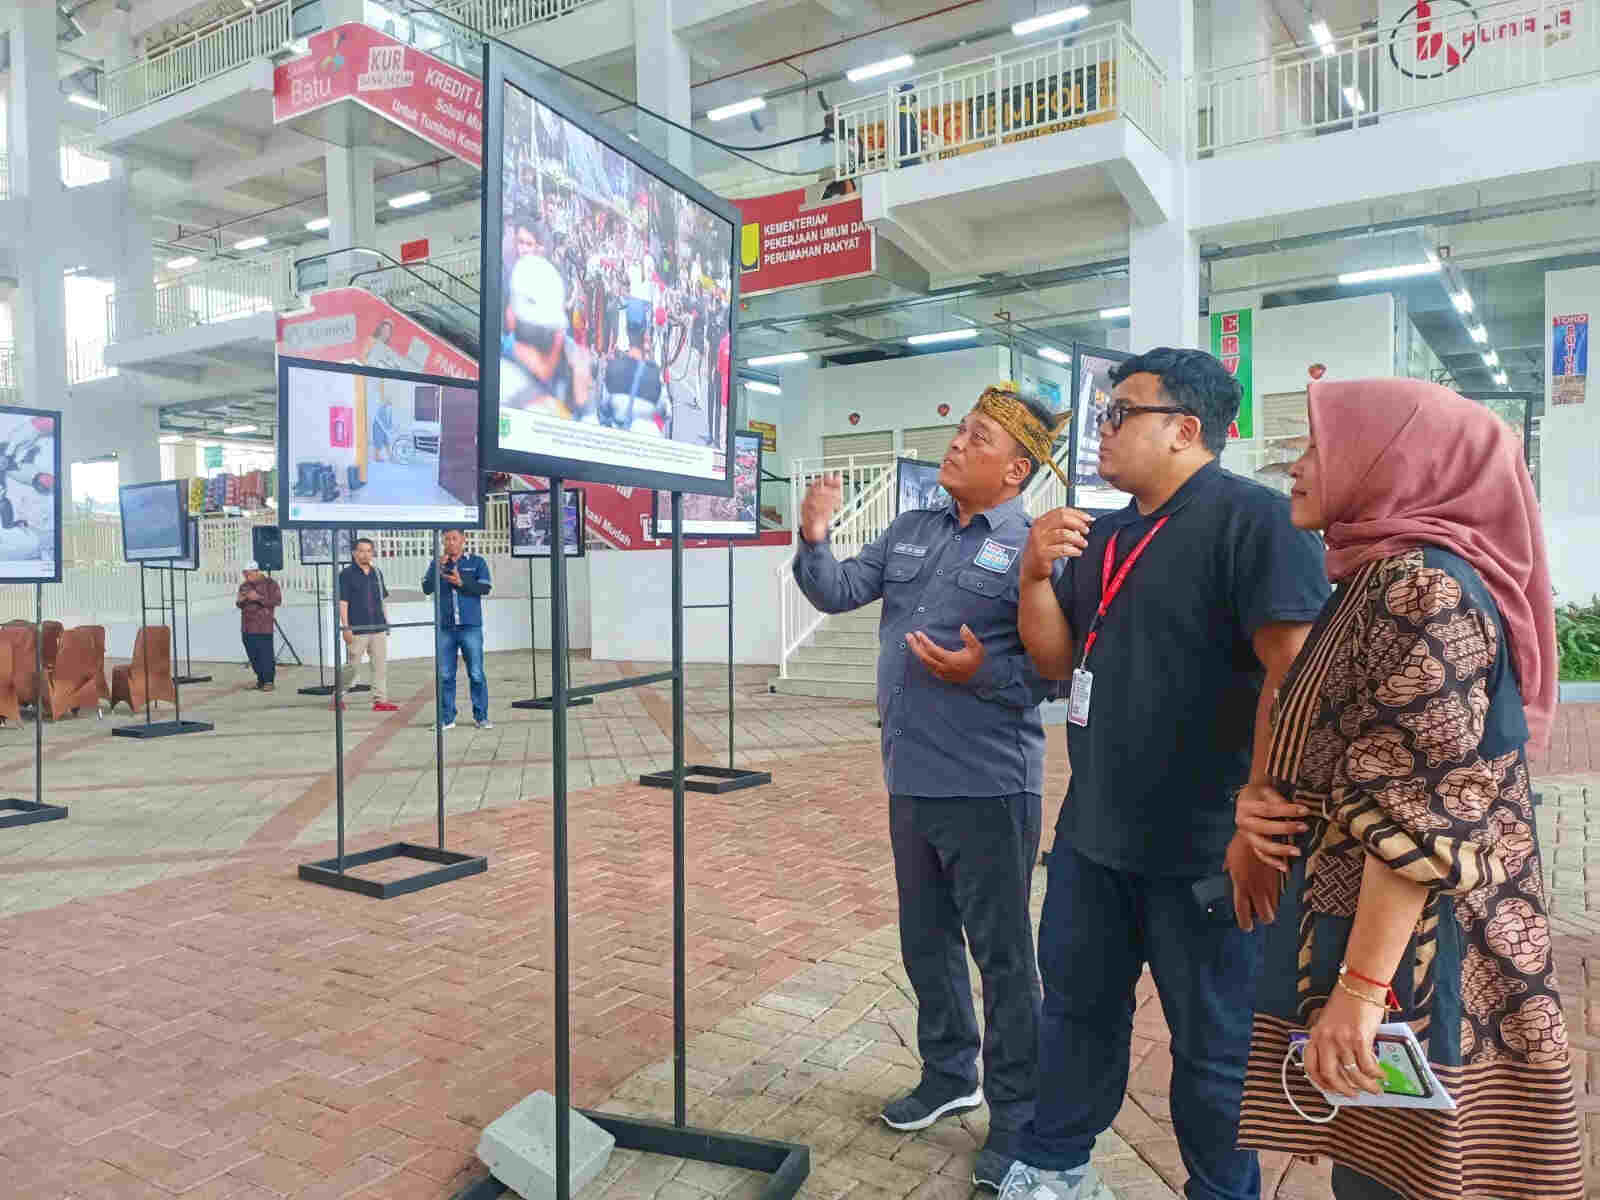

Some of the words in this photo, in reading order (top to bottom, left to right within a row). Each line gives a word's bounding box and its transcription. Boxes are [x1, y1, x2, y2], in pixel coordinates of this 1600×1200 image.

[370, 48, 402, 71] KUR
[425, 70, 474, 100] KREDIT
[764, 213, 828, 236] KEMENTERIAN
[764, 230, 818, 251] PEKERJAAN
[820, 224, 849, 241] UMUM
[764, 244, 821, 265] PERUMAHAN
[823, 236, 860, 254] RAKYAT
